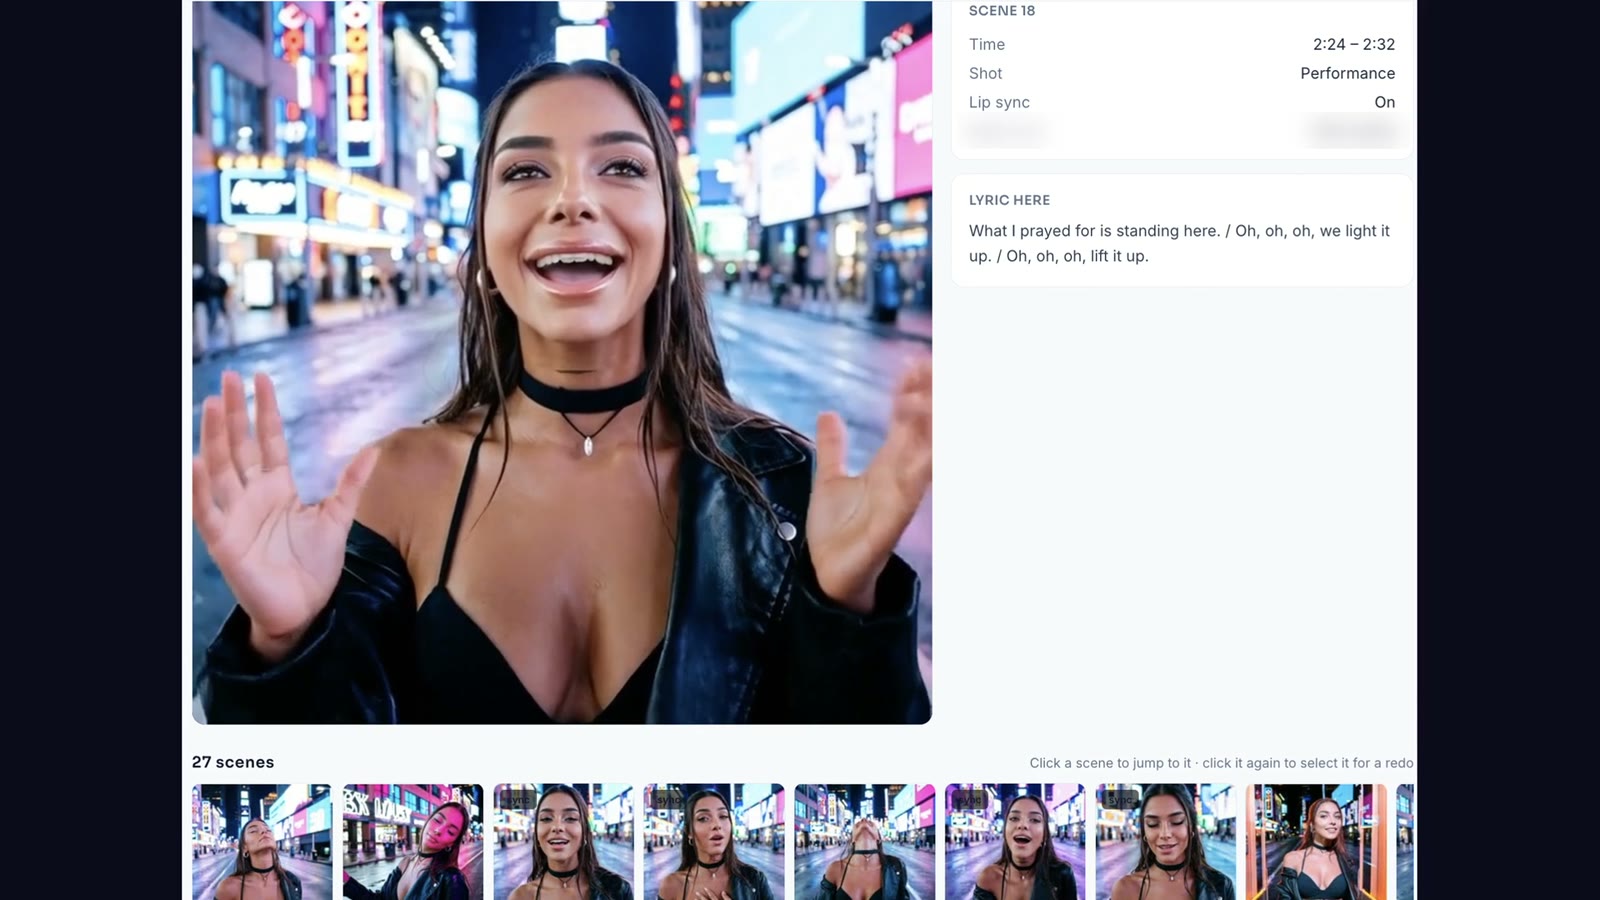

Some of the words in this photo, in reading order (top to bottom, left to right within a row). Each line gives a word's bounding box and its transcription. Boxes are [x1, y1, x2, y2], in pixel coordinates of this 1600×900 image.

[969, 4, 1017, 16] SCENE
[1020, 4, 1036, 16] 18
[969, 37, 1006, 51] Time
[1313, 37, 1347, 51] 2:24
[1363, 37, 1396, 51] 2:32
[969, 66, 1003, 80] Shot
[1300, 66, 1396, 80] Performance
[969, 95, 991, 112] Lip
[995, 98, 1031, 111] sync
[1374, 95, 1396, 109] On
[969, 194, 1010, 206] LYRIC
[1013, 194, 1051, 206] HERE
[969, 223, 1008, 238] What
[1011, 223, 1016, 238] I
[1020, 223, 1071, 242] prayed
[1075, 223, 1096, 238] for
[1100, 223, 1112, 238] is
[1116, 223, 1180, 242] standing
[1184, 223, 1221, 238] here.
[1235, 223, 1261, 240] Oh,
[1265, 223, 1288, 240] oh,
[1292, 223, 1315, 240] oh,
[1319, 226, 1342, 238] we
[1345, 223, 1378, 242] light
[1381, 223, 1391, 238] it
[969, 251, 992, 267] up.
[1006, 248, 1032, 265] Oh,
[1036, 249, 1059, 265] oh,
[1063, 249, 1086, 265] oh,
[1090, 248, 1109, 263] lift
[1113, 248, 1123, 263] it
[1126, 251, 1149, 267] up.
[191, 754, 212, 769] 27
[215, 757, 275, 769] scenes
[1029, 756, 1061, 769] Click
[1064, 759, 1072, 769] a
[1075, 759, 1114, 769] scene
[1117, 757, 1130, 769] to
[1132, 756, 1165, 773] jump
[1168, 757, 1180, 769] to
[1183, 756, 1192, 769] it
[1202, 756, 1232, 769] click
[1235, 756, 1243, 769] it
[1246, 756, 1281, 773] again
[1284, 757, 1297, 769] to
[1300, 756, 1339, 769] select
[1341, 756, 1350, 769] it
[1352, 756, 1371, 769] for
[1374, 759, 1382, 769] a
[1385, 756, 1415, 769] redo
[657, 797, 681, 806] sync
[1109, 797, 1133, 806] sync
